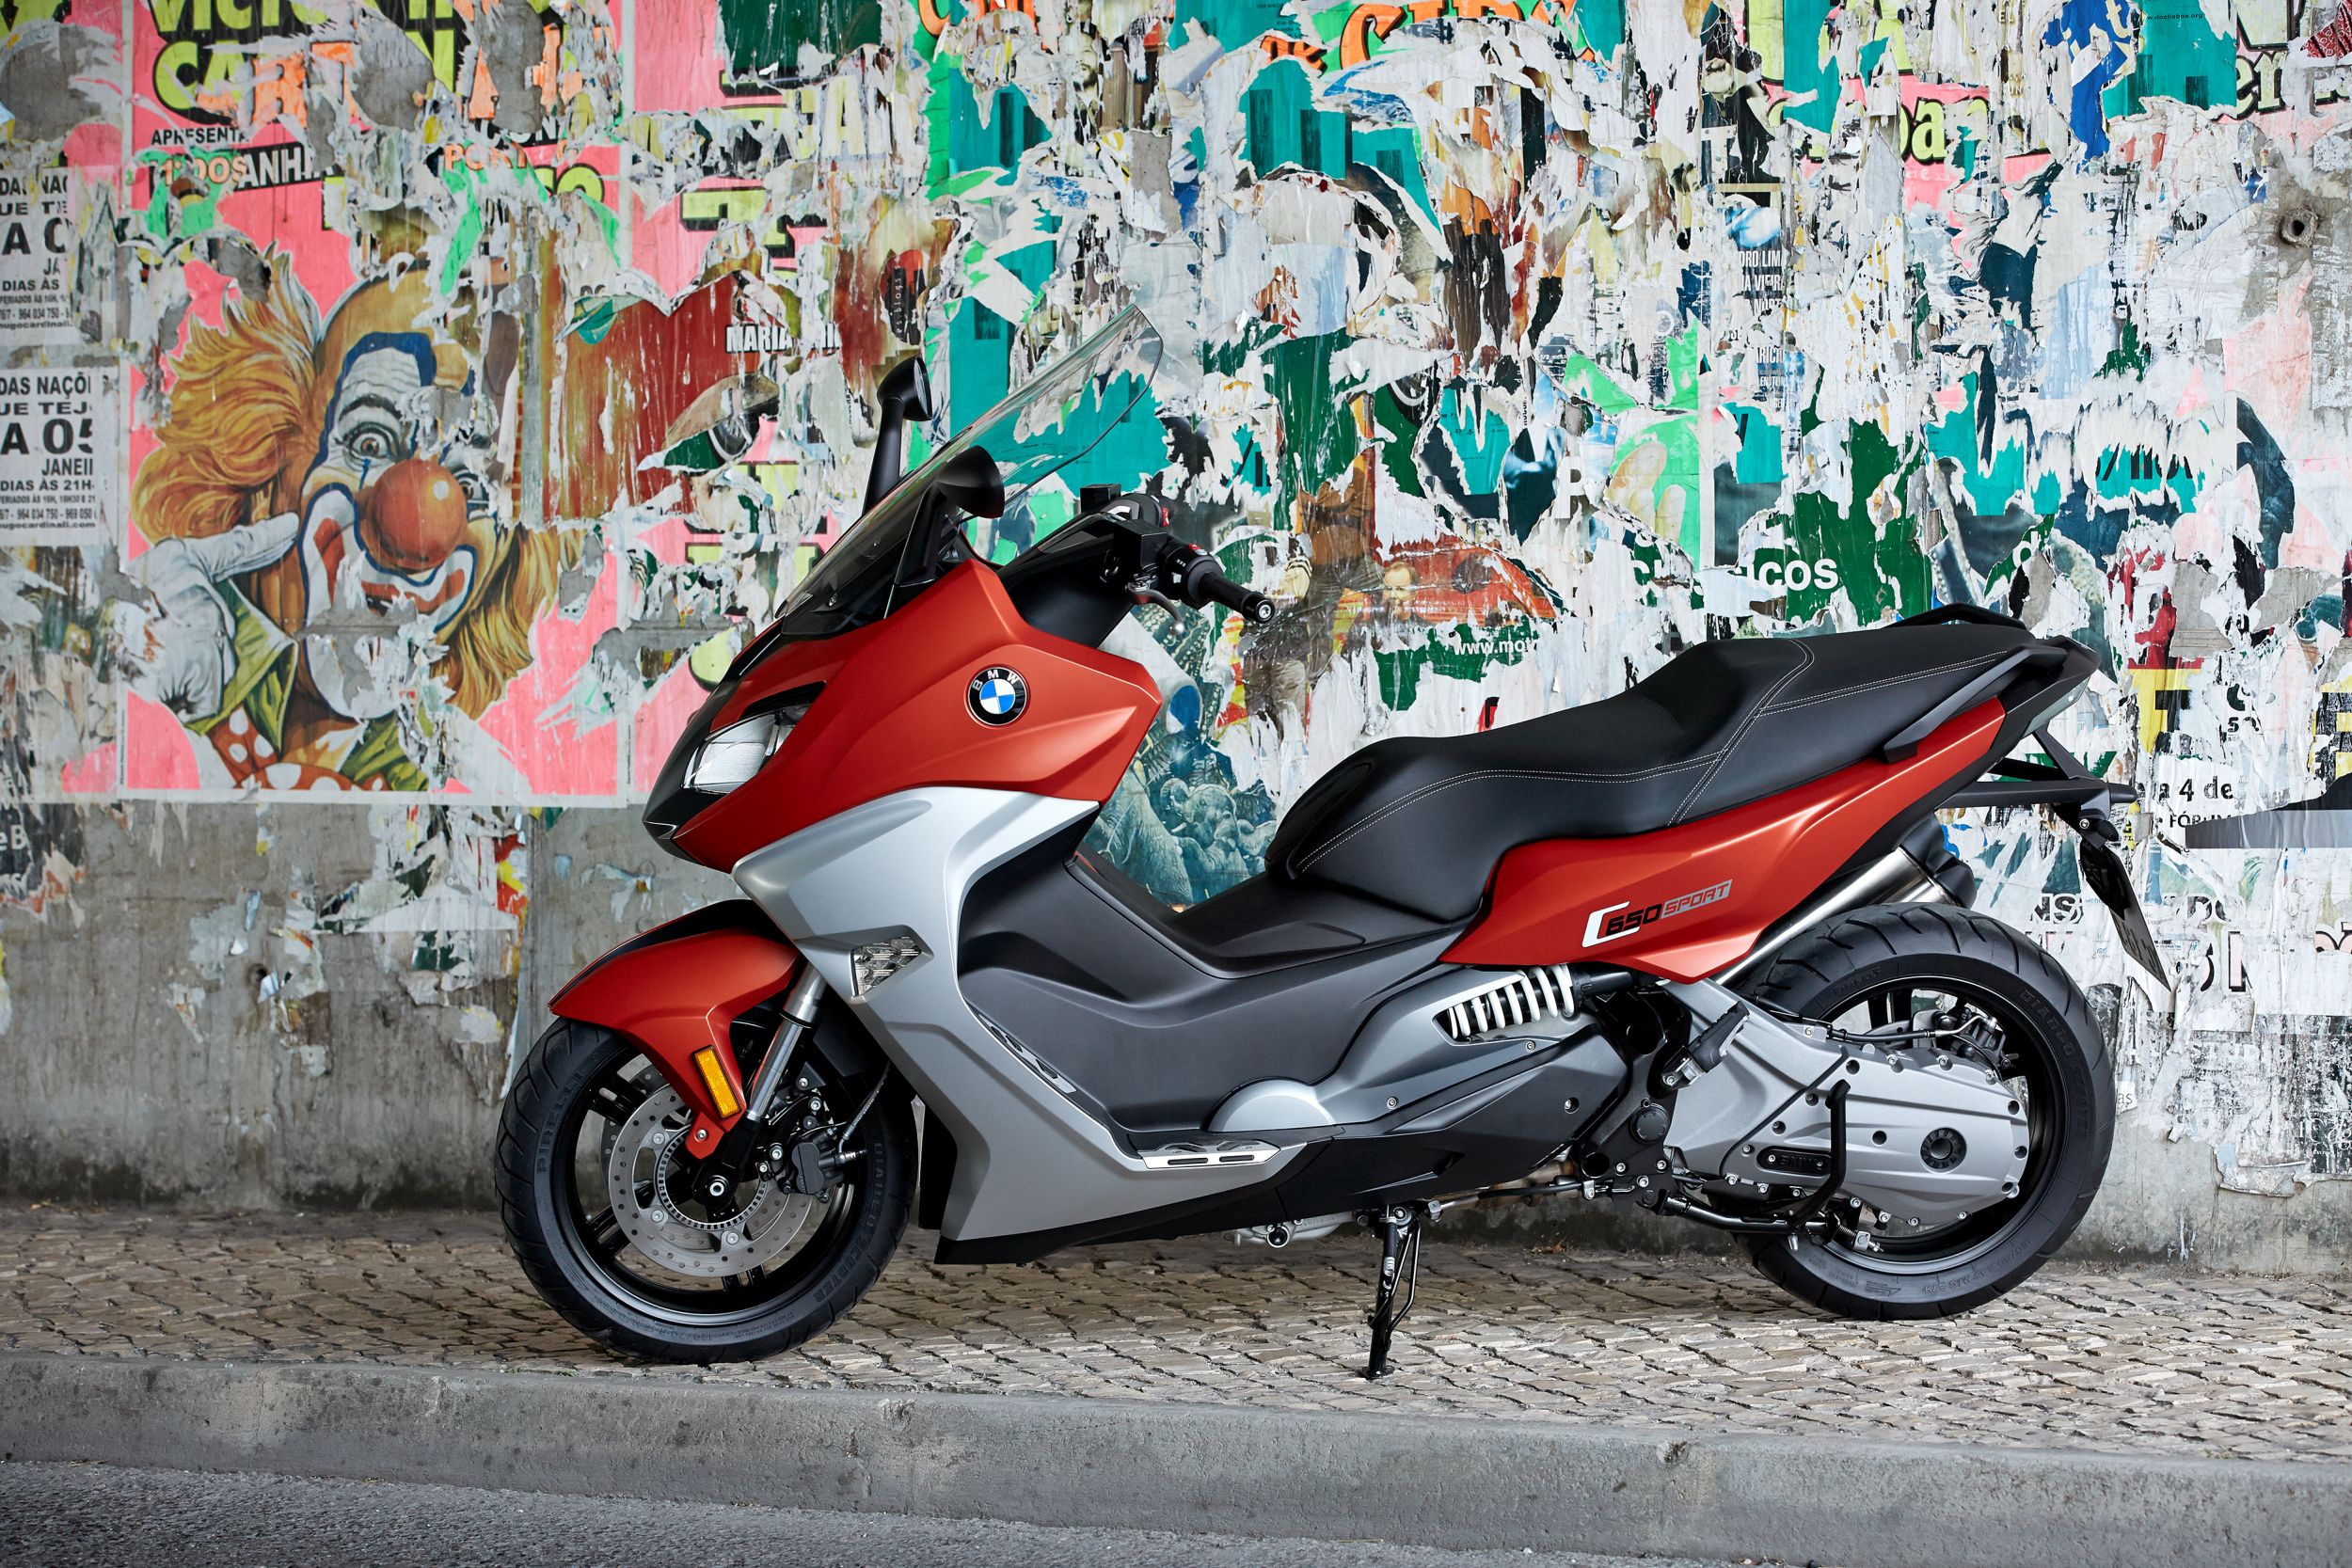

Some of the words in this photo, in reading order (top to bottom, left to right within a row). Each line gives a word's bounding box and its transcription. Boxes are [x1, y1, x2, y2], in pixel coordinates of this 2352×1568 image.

[2, 280, 36, 292] DIAS
[0, 480, 34, 491] DIAS
[972, 669, 1020, 691] BMW
[2179, 778, 2195, 801] 4
[1663, 880, 1731, 918] SPORT
